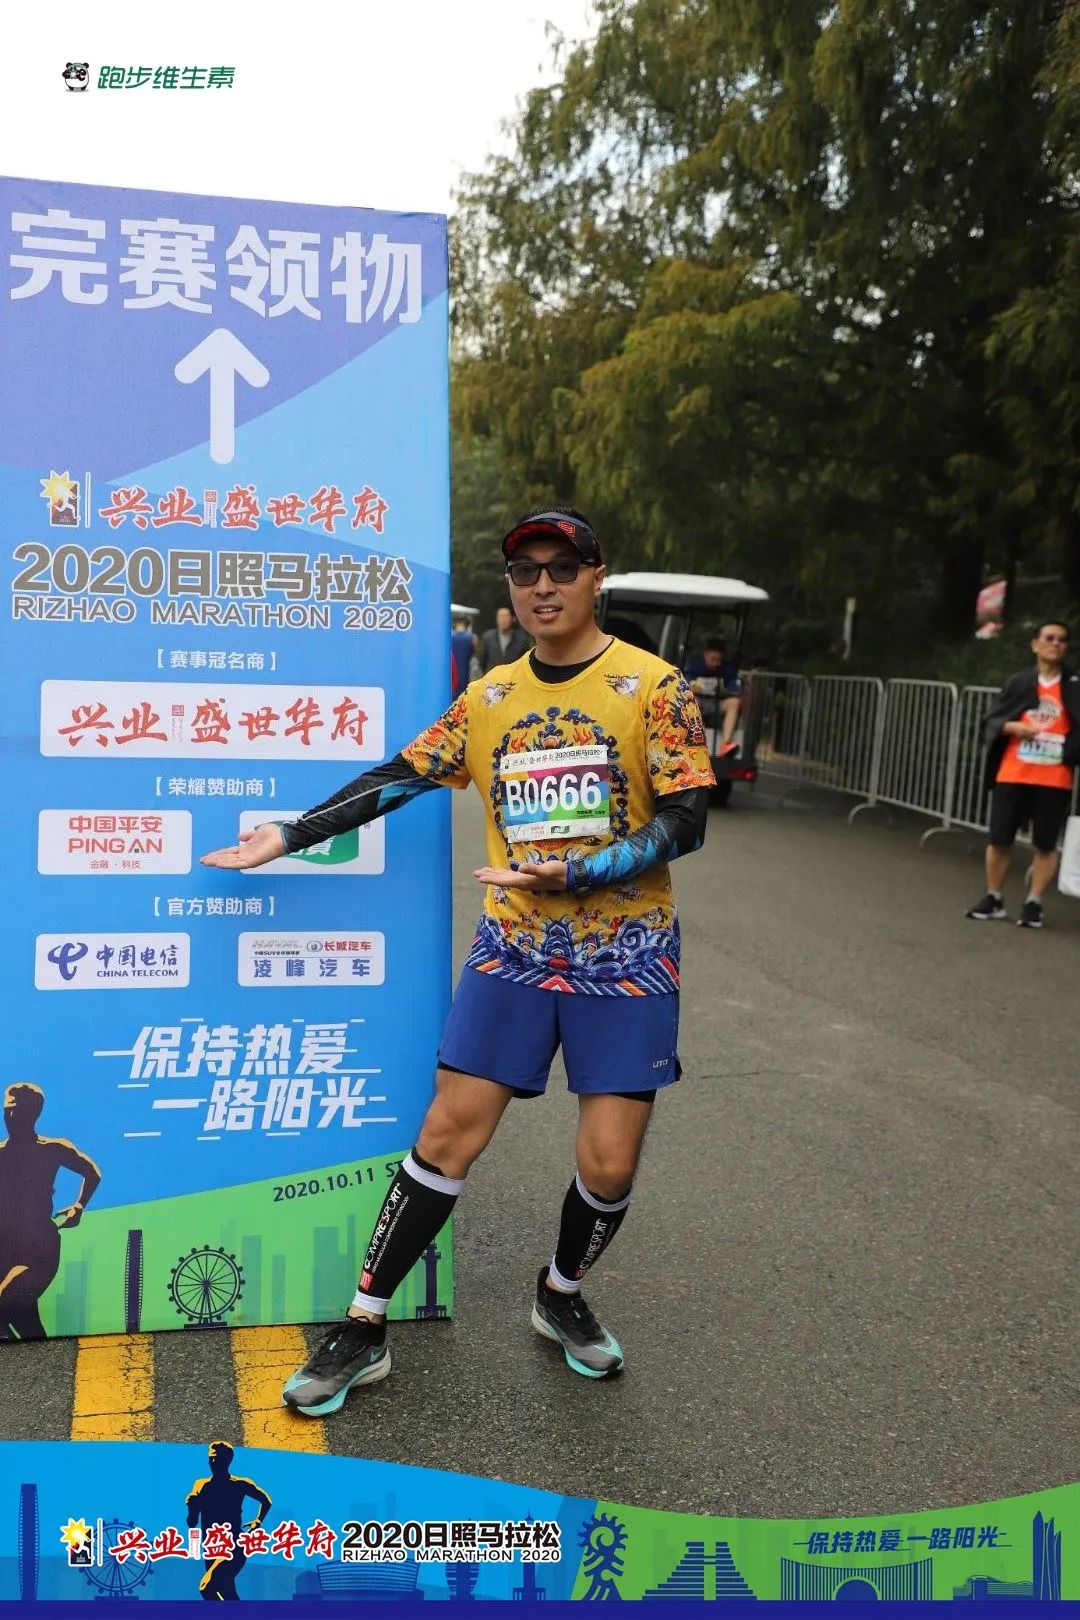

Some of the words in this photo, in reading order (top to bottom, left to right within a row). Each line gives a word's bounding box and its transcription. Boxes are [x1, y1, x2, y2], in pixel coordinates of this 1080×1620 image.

[9, 208, 423, 325] 完赛领物
[12, 543, 414, 605] 2020日照马拉松
[12, 596, 137, 625] RIZHAO
[152, 601, 331, 630] MARATHON
[344, 606, 412, 632] 2020
[505, 771, 602, 817] B0666
[68, 814, 164, 834] 中国平安
[96, 943, 180, 969] 中国电信
[324, 940, 372, 951] 长城汽车
[96, 969, 129, 978] CHINA
[131, 969, 179, 978] TELECOM
[129, 1023, 354, 1079] 保持热爱
[152, 1076, 380, 1131] 一路阳光
[273, 1167, 375, 1202] 2020.10.11
[385, 1159, 403, 1178] ST
